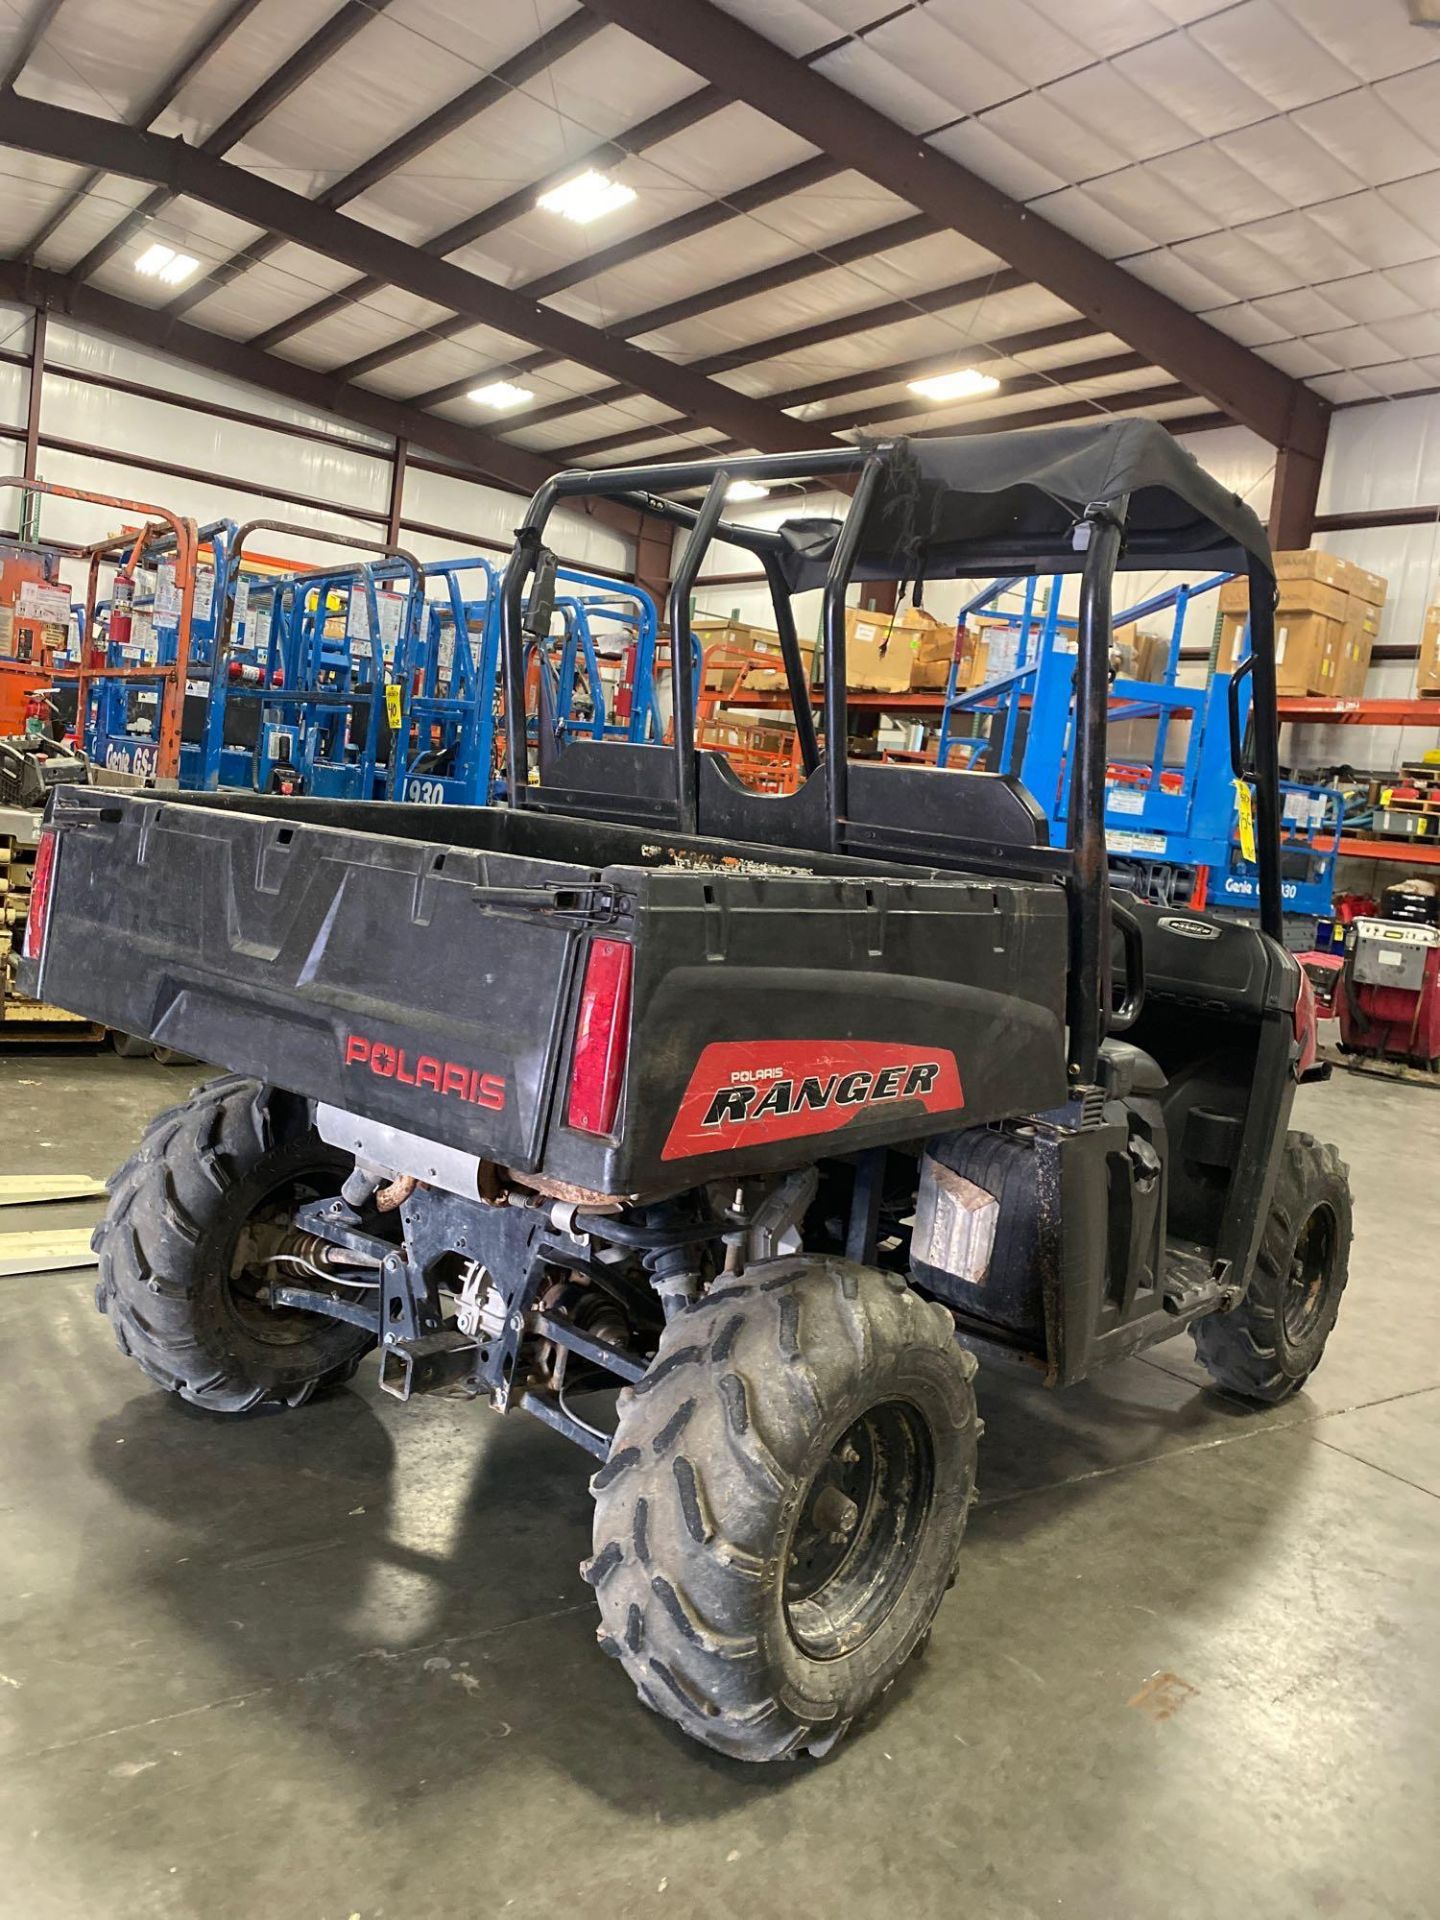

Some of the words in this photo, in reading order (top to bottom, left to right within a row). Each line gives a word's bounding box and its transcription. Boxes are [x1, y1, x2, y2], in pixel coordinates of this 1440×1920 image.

[1225, 877, 1253, 896] Genie
[345, 1034, 505, 1111] POLARIS
[730, 1066, 784, 1084] POLARIS
[700, 1061, 941, 1127] RANGER
